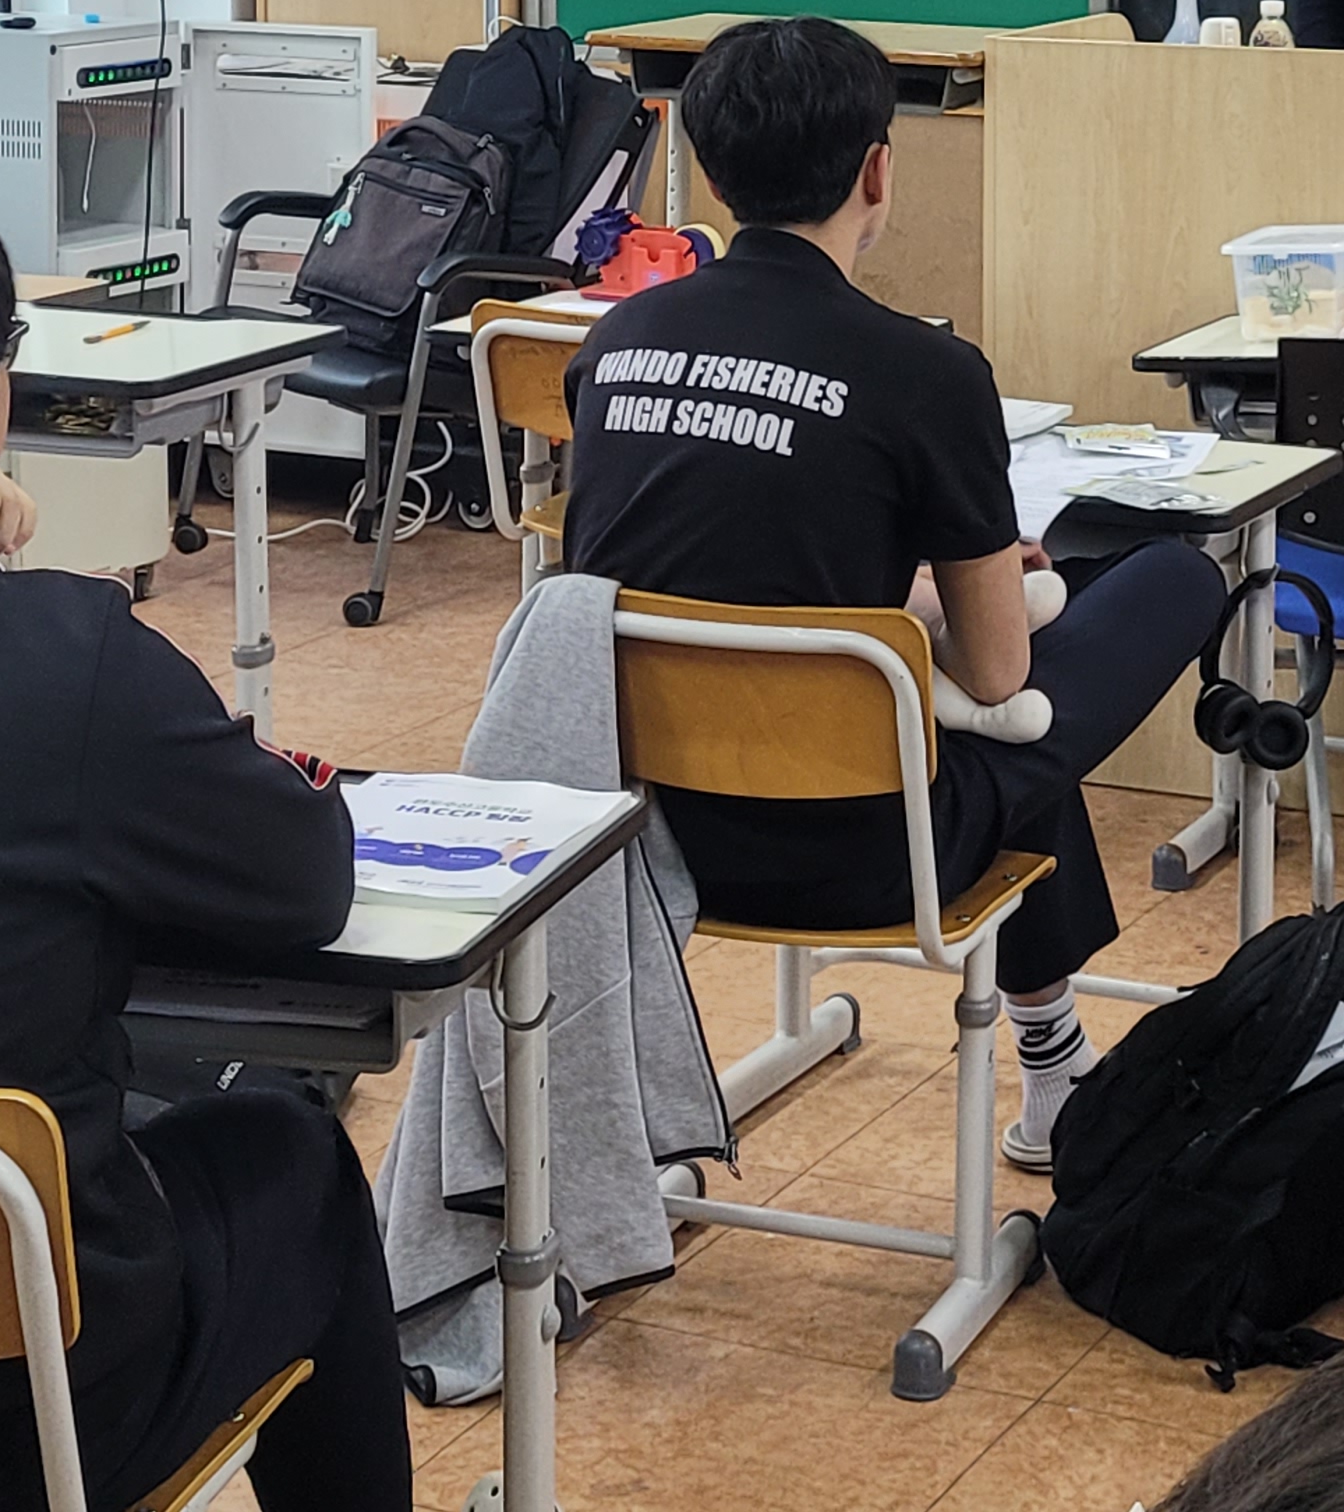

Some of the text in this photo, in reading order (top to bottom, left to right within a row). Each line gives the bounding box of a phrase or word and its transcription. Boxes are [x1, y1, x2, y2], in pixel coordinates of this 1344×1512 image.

[594, 348, 849, 418] WANDO FISHERIES
[604, 395, 795, 457] HIGH SCHOOL
[395, 804, 482, 819] HACCP
